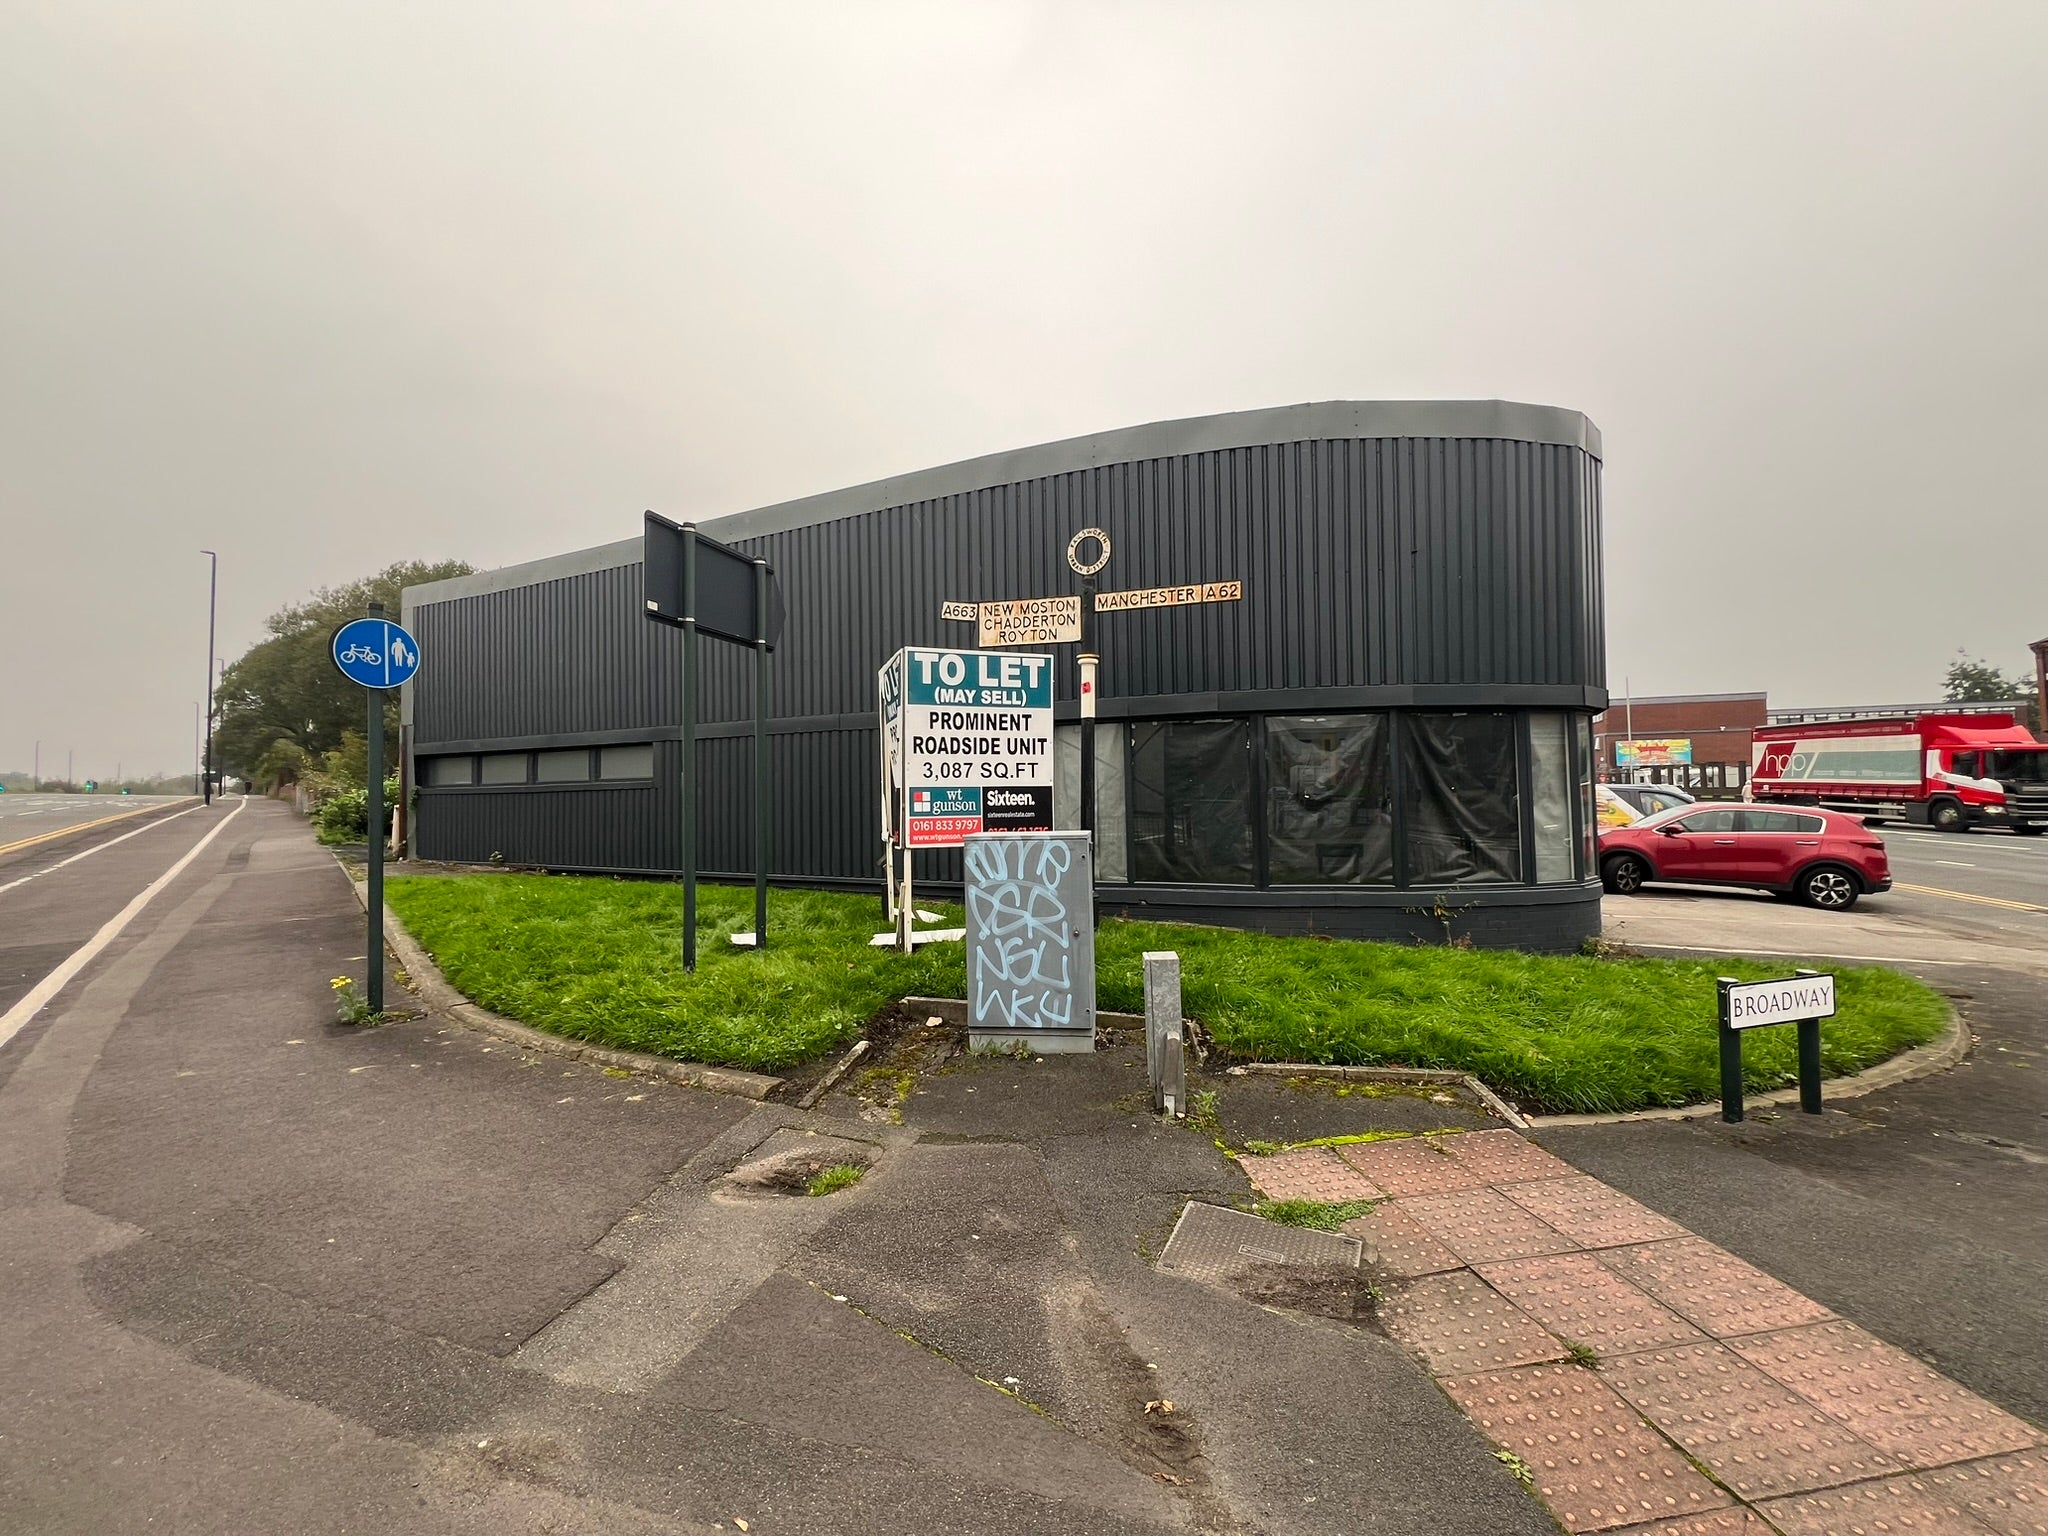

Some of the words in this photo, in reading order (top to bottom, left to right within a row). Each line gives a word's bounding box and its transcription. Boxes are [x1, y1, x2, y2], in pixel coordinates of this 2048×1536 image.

[1098, 588, 1195, 609] MANCHESTER
[1206, 584, 1238, 599] A62
[943, 605, 976, 618] A663
[984, 604, 1014, 617] NEW
[1020, 600, 1076, 615] MOSTON
[984, 613, 1076, 631] CHADDERTON
[999, 628, 1058, 643] ROYTON
[914, 652, 966, 686] TO
[979, 656, 1045, 688] LET
[934, 686, 976, 704] (MAY
[981, 689, 1027, 707] SELL)
[929, 711, 1032, 732] PROMINENT
[913, 736, 1001, 755] ROADSIDE
[1007, 738, 1048, 755] UNIT
[923, 762, 974, 781] 3,087
[980, 762, 1039, 779] SQ.FT
[1765, 750, 1807, 778] hpp
[947, 789, 963, 801] wt
[987, 790, 1036, 807] Sixteen.
[932, 800, 977, 815] gunson
[913, 821, 934, 831] 0161
[935, 820, 952, 830] 833
[955, 819, 979, 830] 9797
[1733, 986, 1831, 1017] BROADWAY
